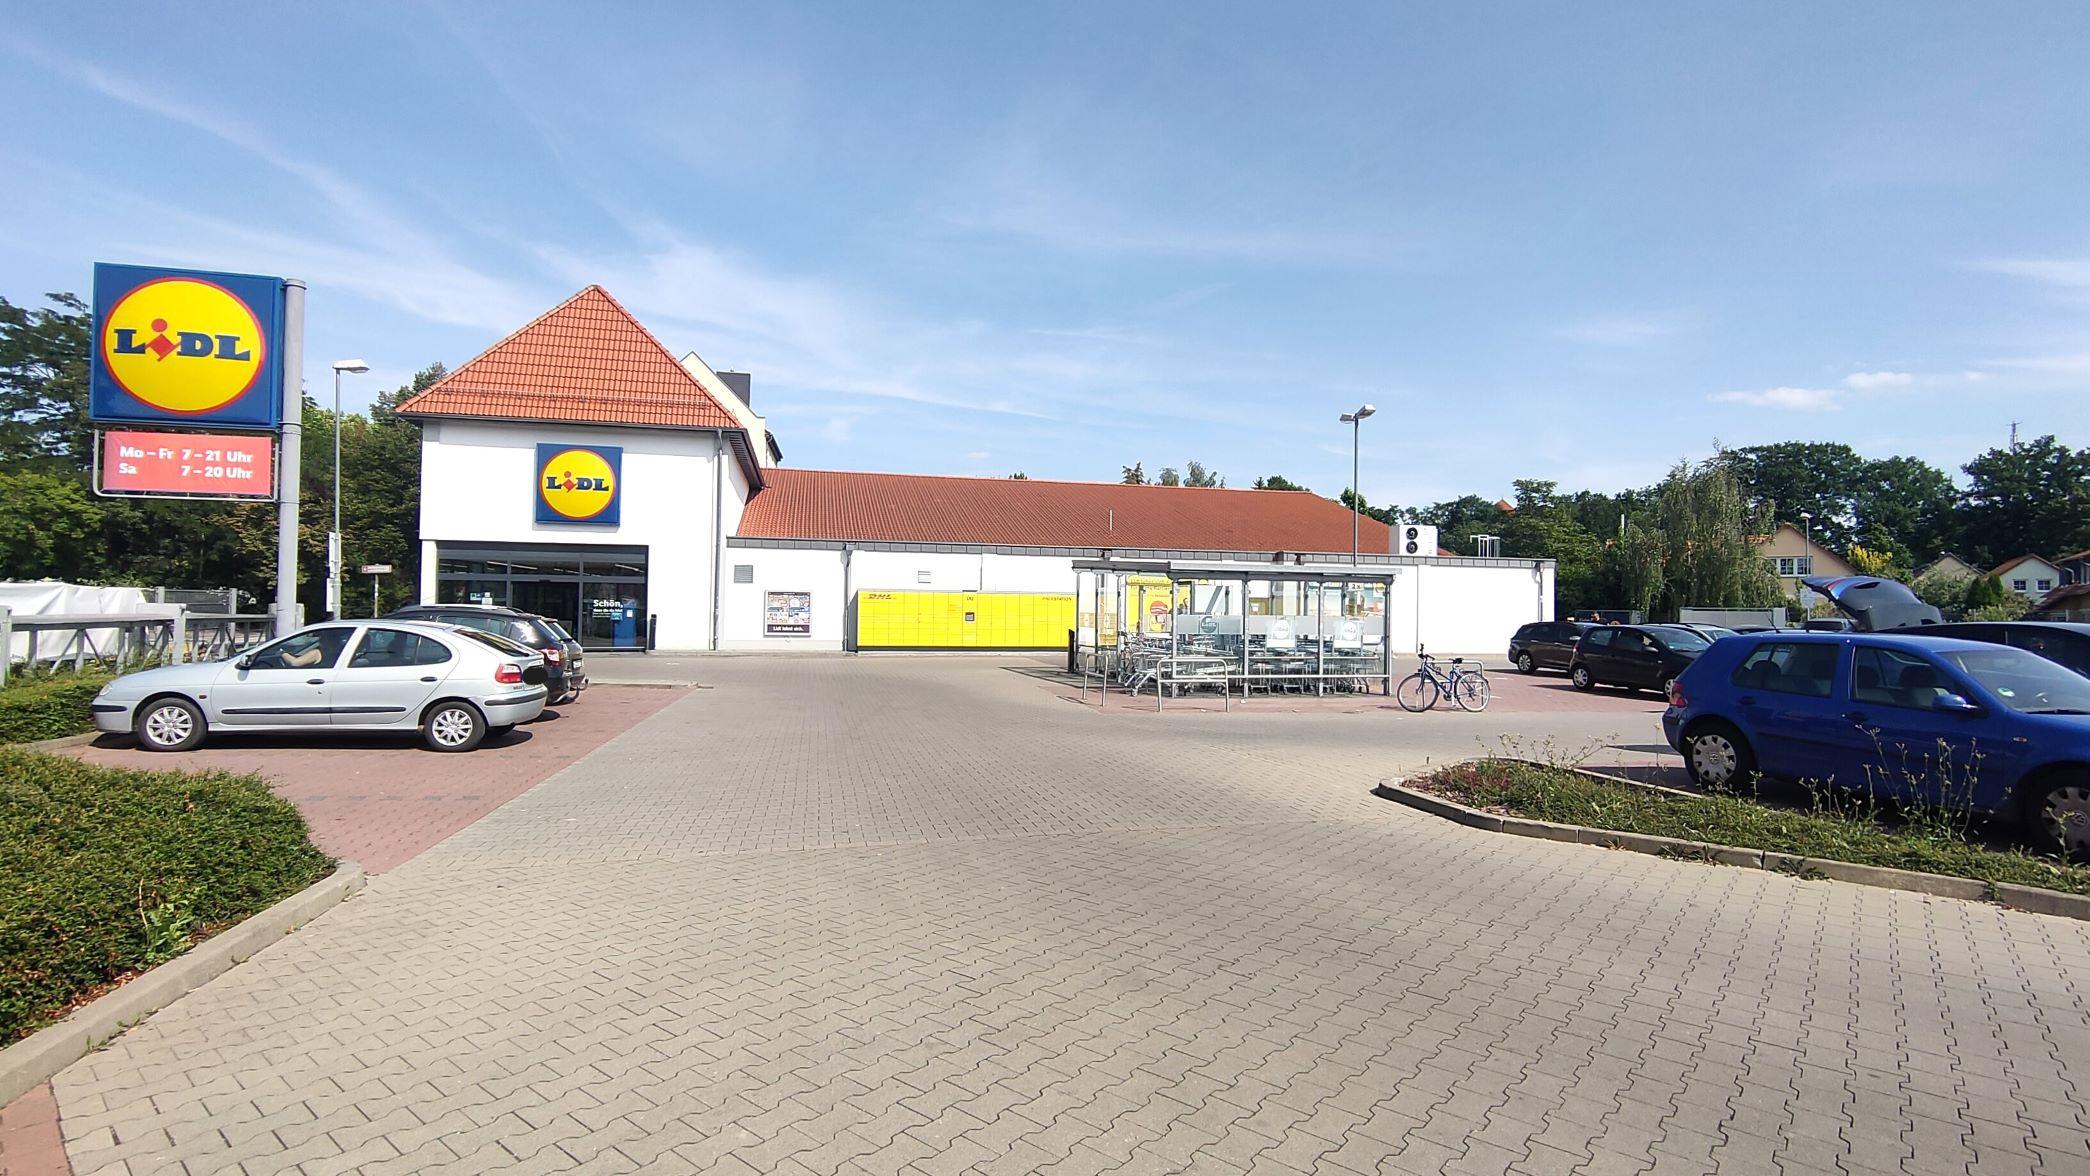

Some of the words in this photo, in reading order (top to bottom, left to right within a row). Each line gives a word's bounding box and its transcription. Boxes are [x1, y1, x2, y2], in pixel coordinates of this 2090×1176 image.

[119, 446, 144, 458] Mo
[158, 447, 175, 459] Fr
[181, 448, 192, 460] 7
[205, 449, 221, 461] 21
[226, 450, 253, 463] Uhr
[118, 462, 138, 474] Sa
[181, 465, 191, 476] 7
[204, 466, 224, 478] 20
[225, 466, 253, 479] Uhr
